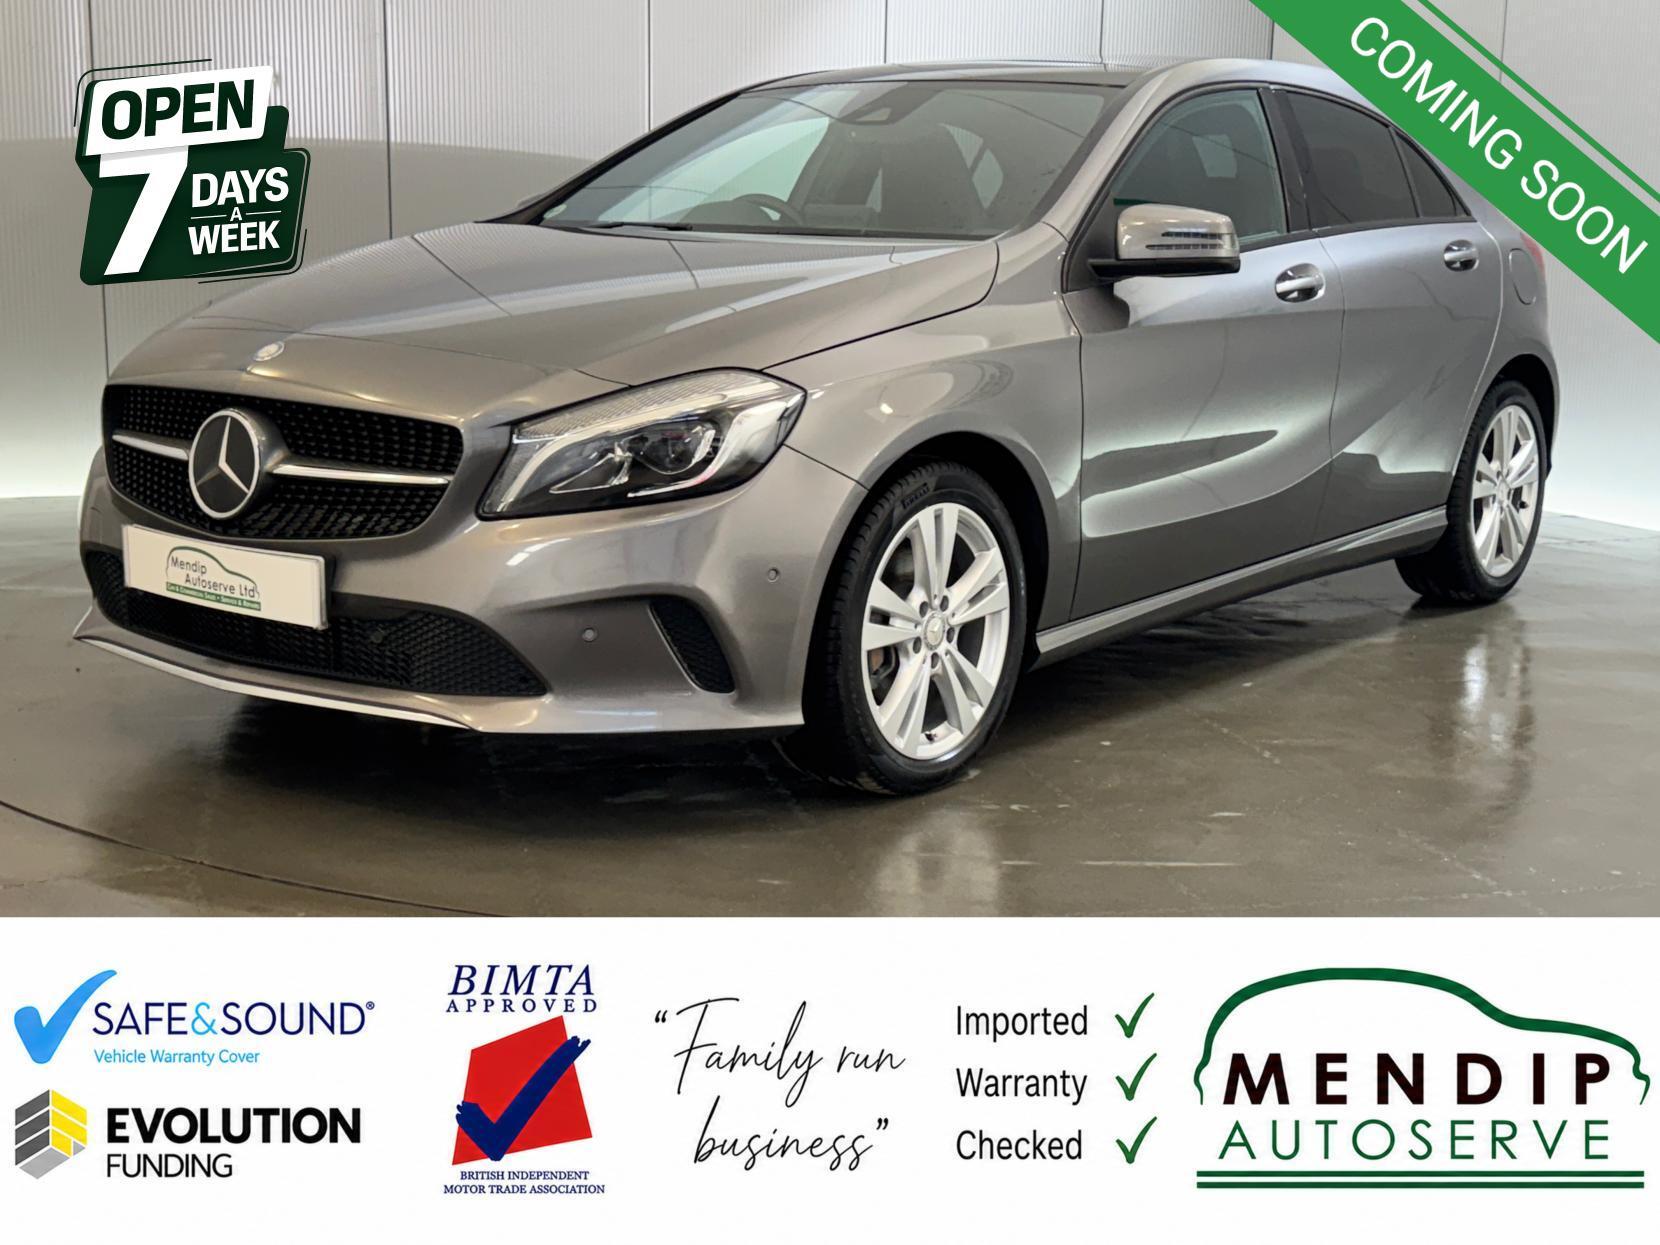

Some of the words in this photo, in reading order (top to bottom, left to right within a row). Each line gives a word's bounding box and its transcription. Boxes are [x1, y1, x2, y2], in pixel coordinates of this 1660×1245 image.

[171, 556, 207, 576] Mendip
[184, 573, 236, 595] Autoserve
[239, 584, 256, 599] Ltd
